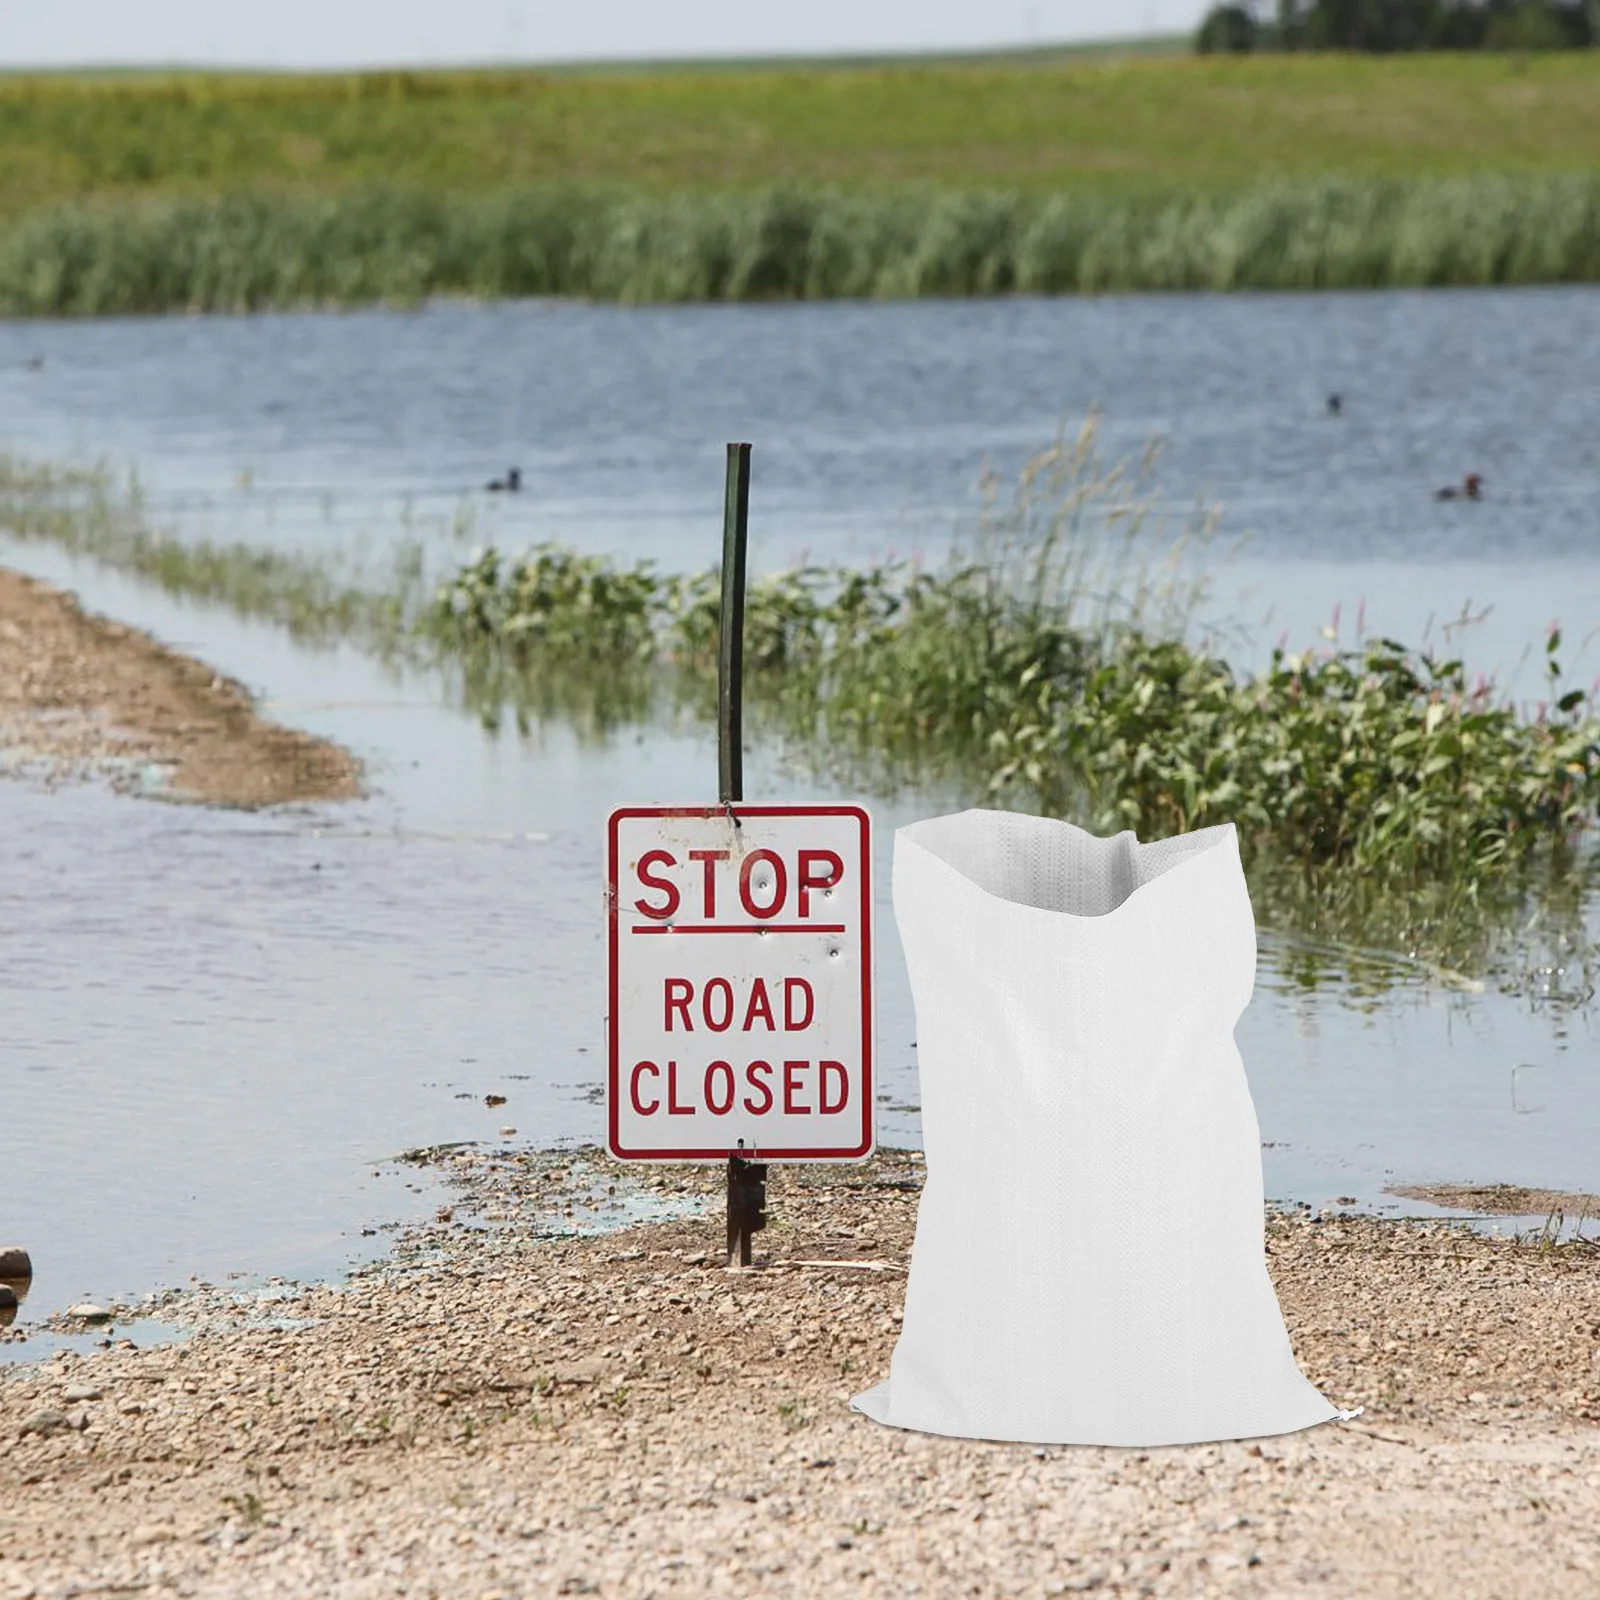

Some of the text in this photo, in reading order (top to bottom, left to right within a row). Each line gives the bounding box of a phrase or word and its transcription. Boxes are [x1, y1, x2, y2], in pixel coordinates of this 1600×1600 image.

[634, 849, 845, 920] STOP
[664, 977, 815, 1032] ROAD
[630, 1060, 849, 1116] CLOSED
